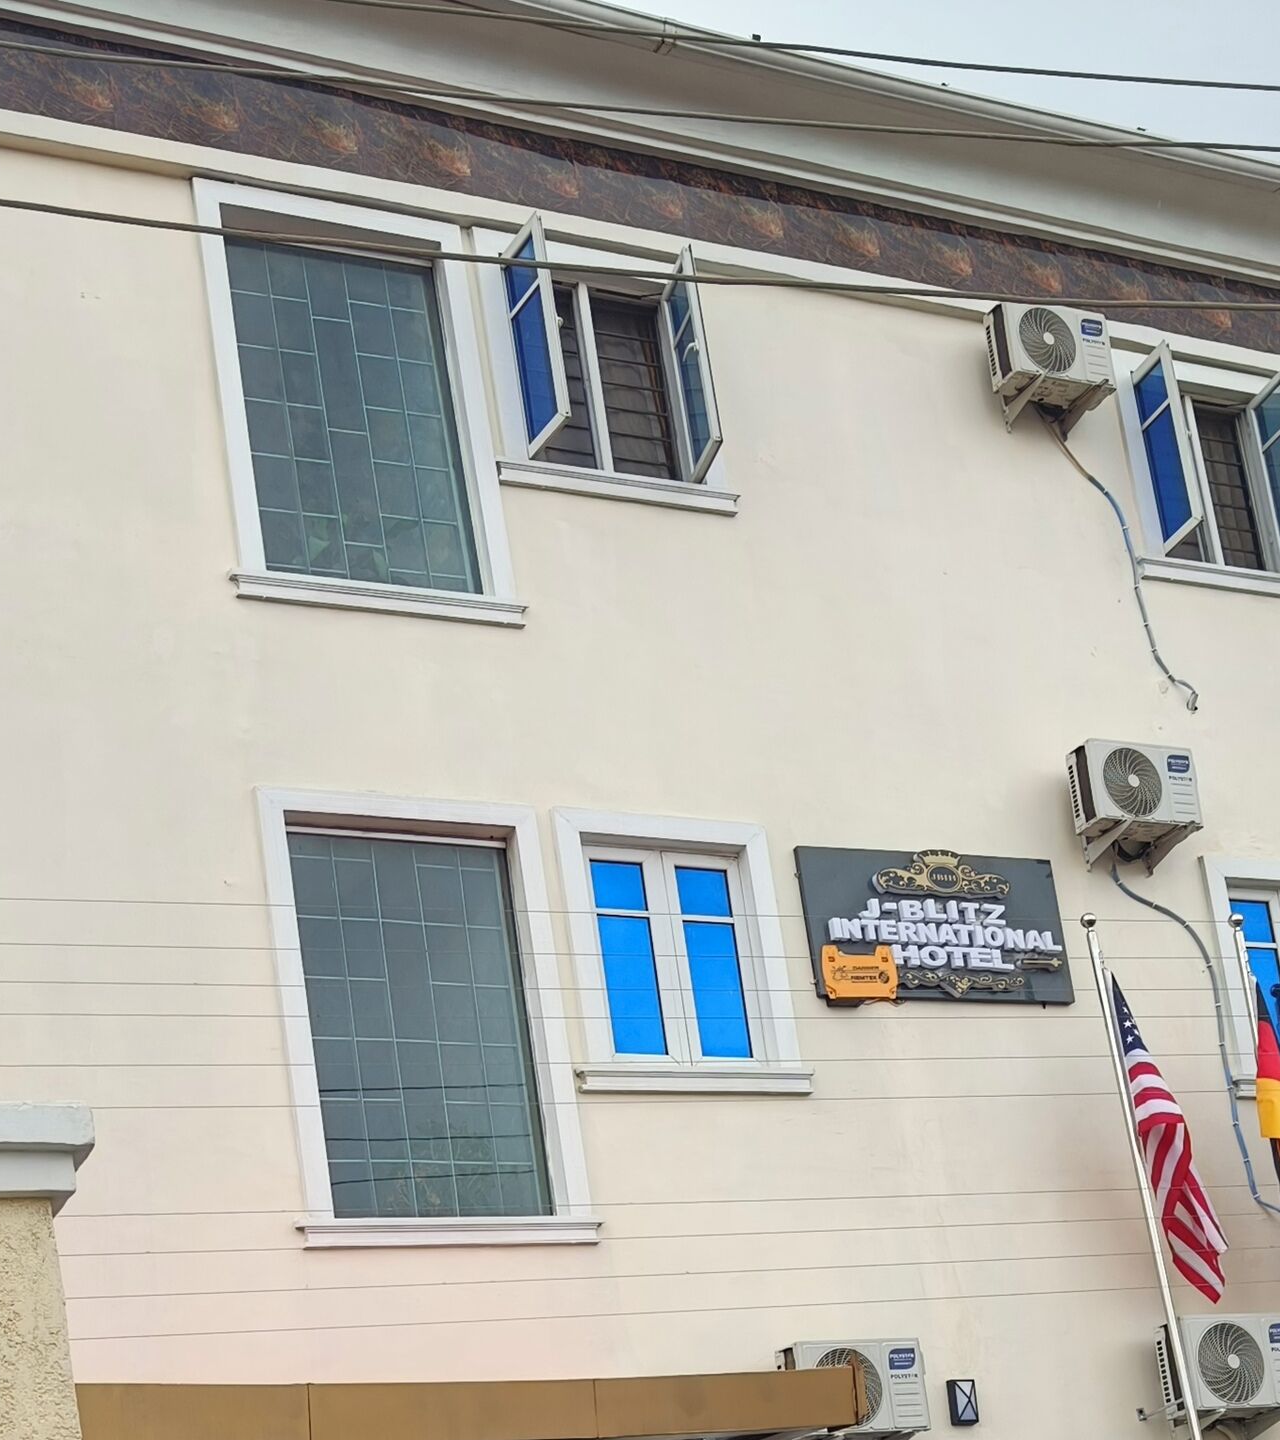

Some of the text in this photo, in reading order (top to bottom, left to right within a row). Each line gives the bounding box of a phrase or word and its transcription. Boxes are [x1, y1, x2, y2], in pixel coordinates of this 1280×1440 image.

[858, 898, 1006, 927] J-BLITZ
[828, 917, 1062, 954] INTERNATIONAL
[890, 944, 1015, 972] HOTEL
